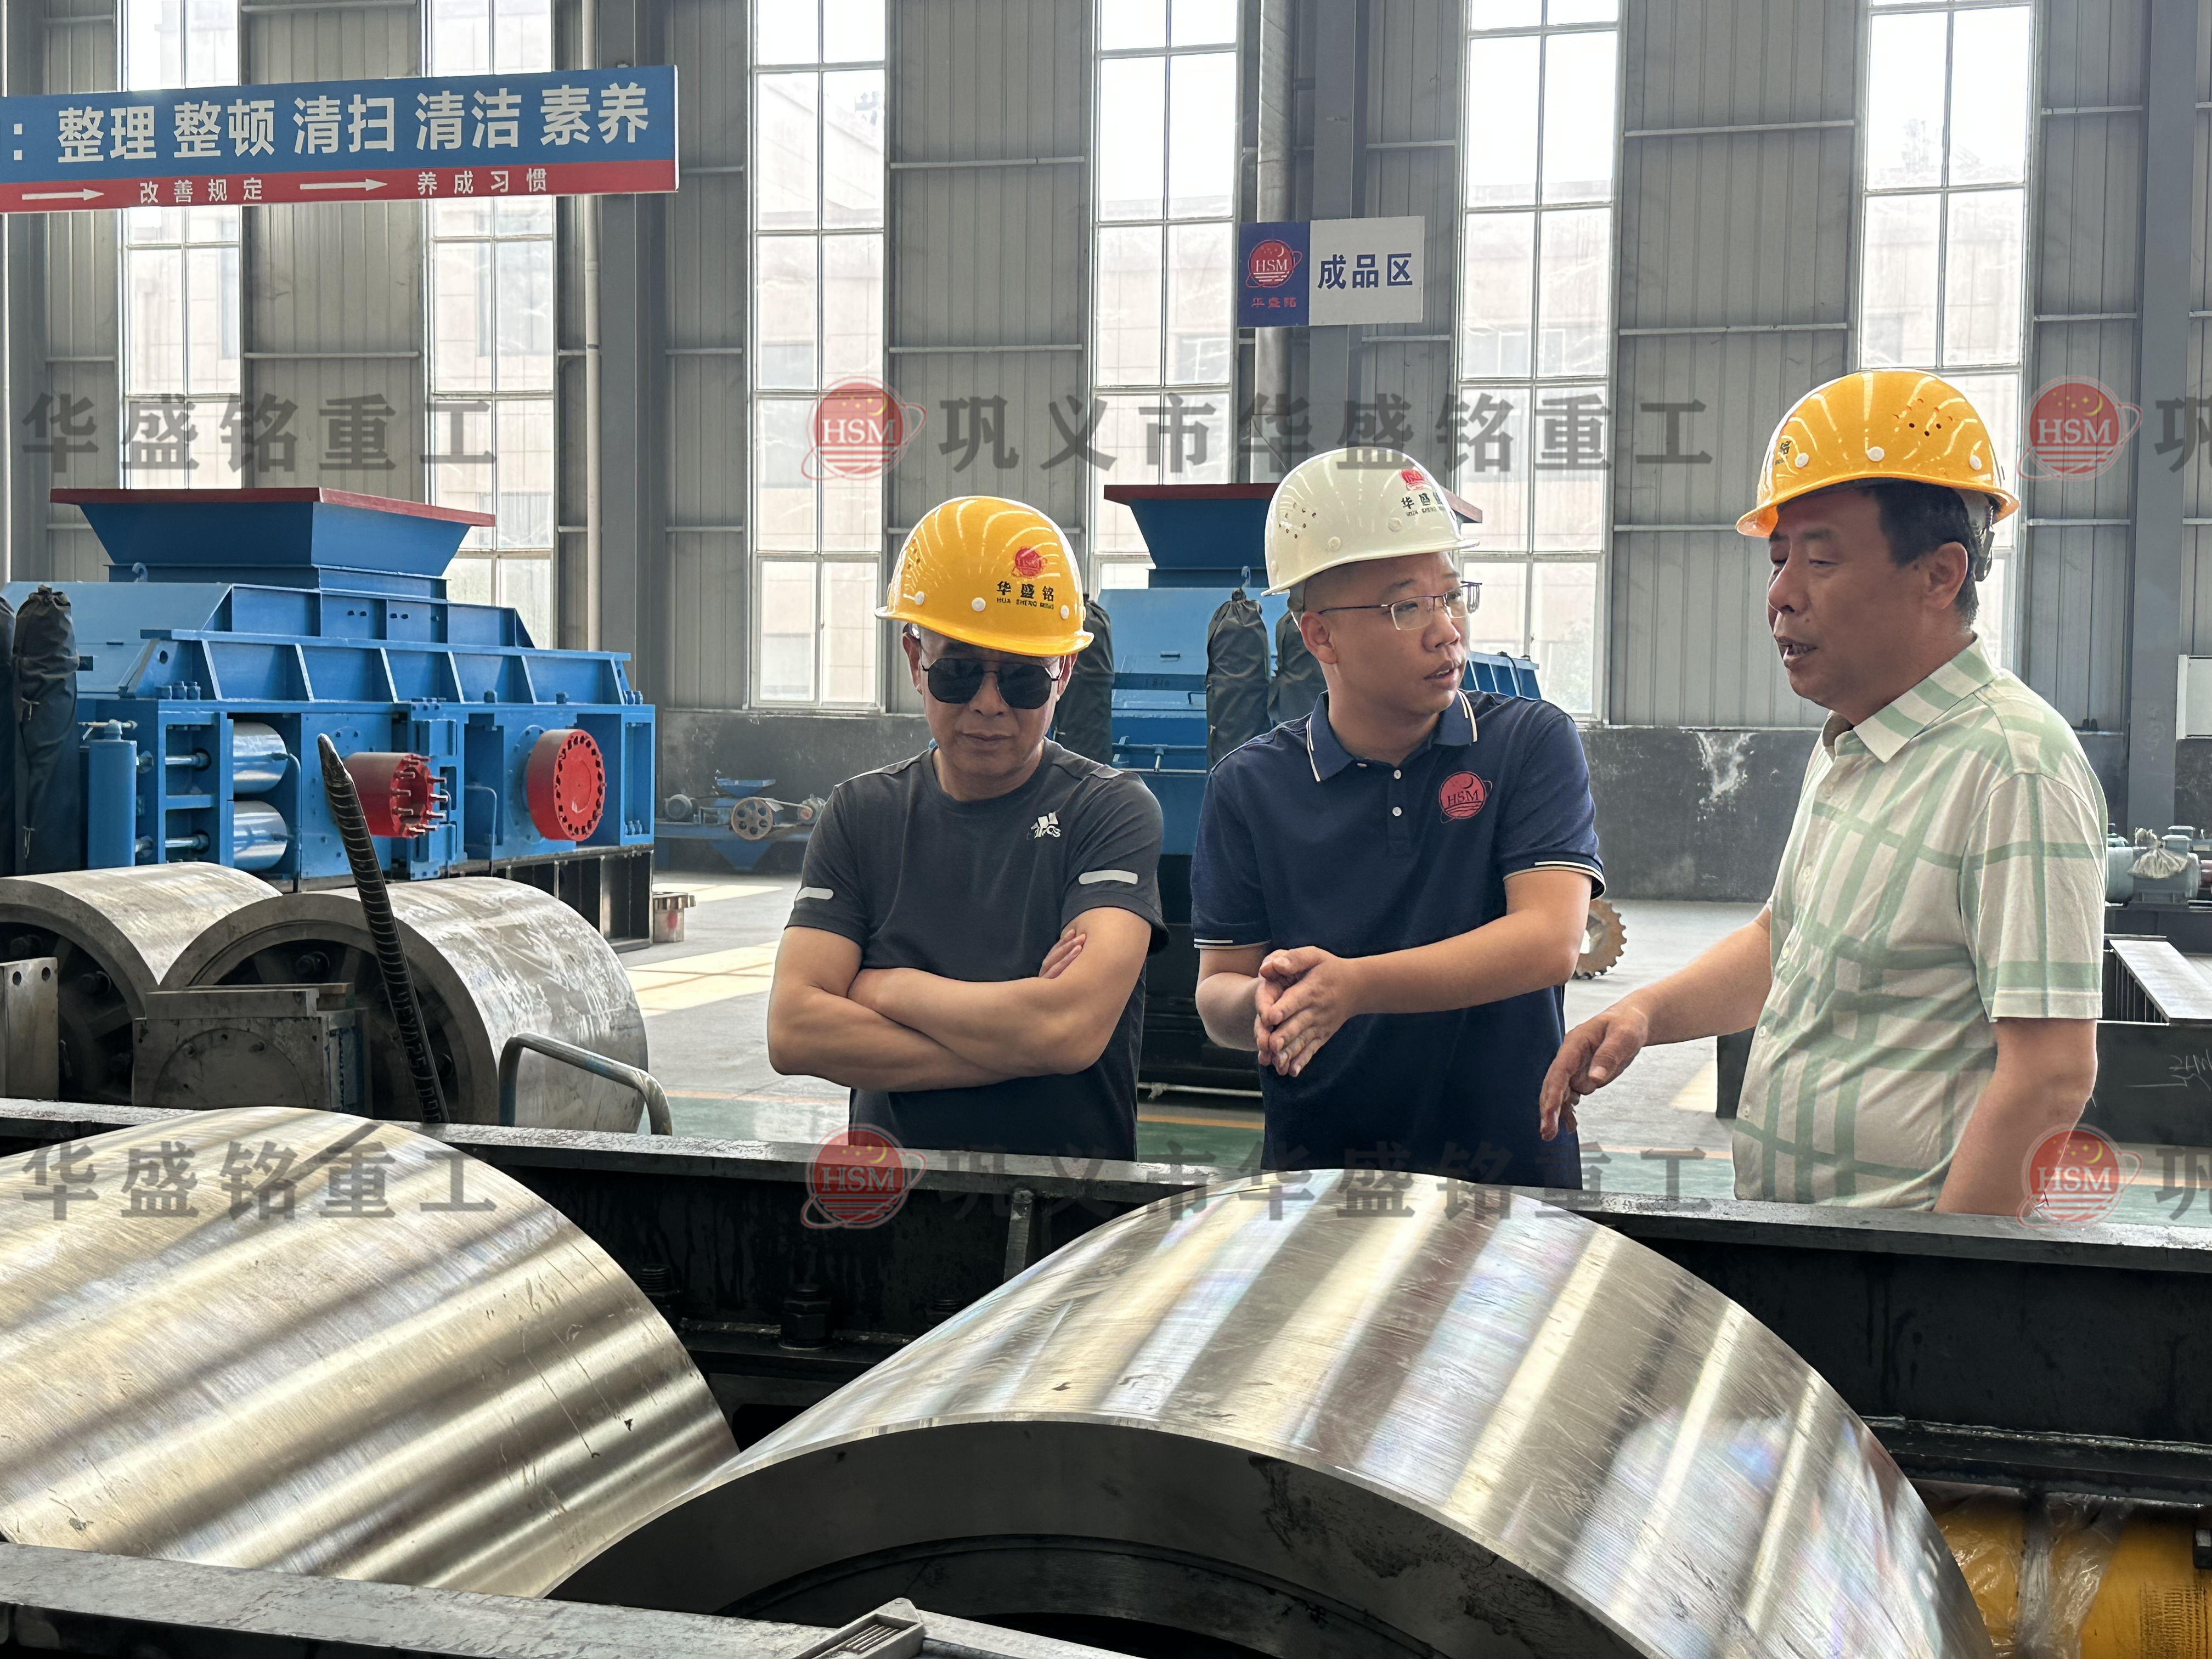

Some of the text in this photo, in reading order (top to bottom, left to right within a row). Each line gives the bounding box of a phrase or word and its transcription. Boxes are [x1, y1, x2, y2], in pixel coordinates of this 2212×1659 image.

[58, 105, 157, 163] 整理
[174, 98, 275, 159] 整顿
[293, 93, 396, 155] 清扫
[415, 88, 523, 150] 清洁
[540, 81, 650, 147] 素养
[139, 177, 263, 204] 改善规定
[417, 167, 548, 196] 养成习惯
[1256, 258, 1288, 273] HSM
[1317, 253, 1413, 290] 成品区
[1447, 789, 1479, 806] HSM
